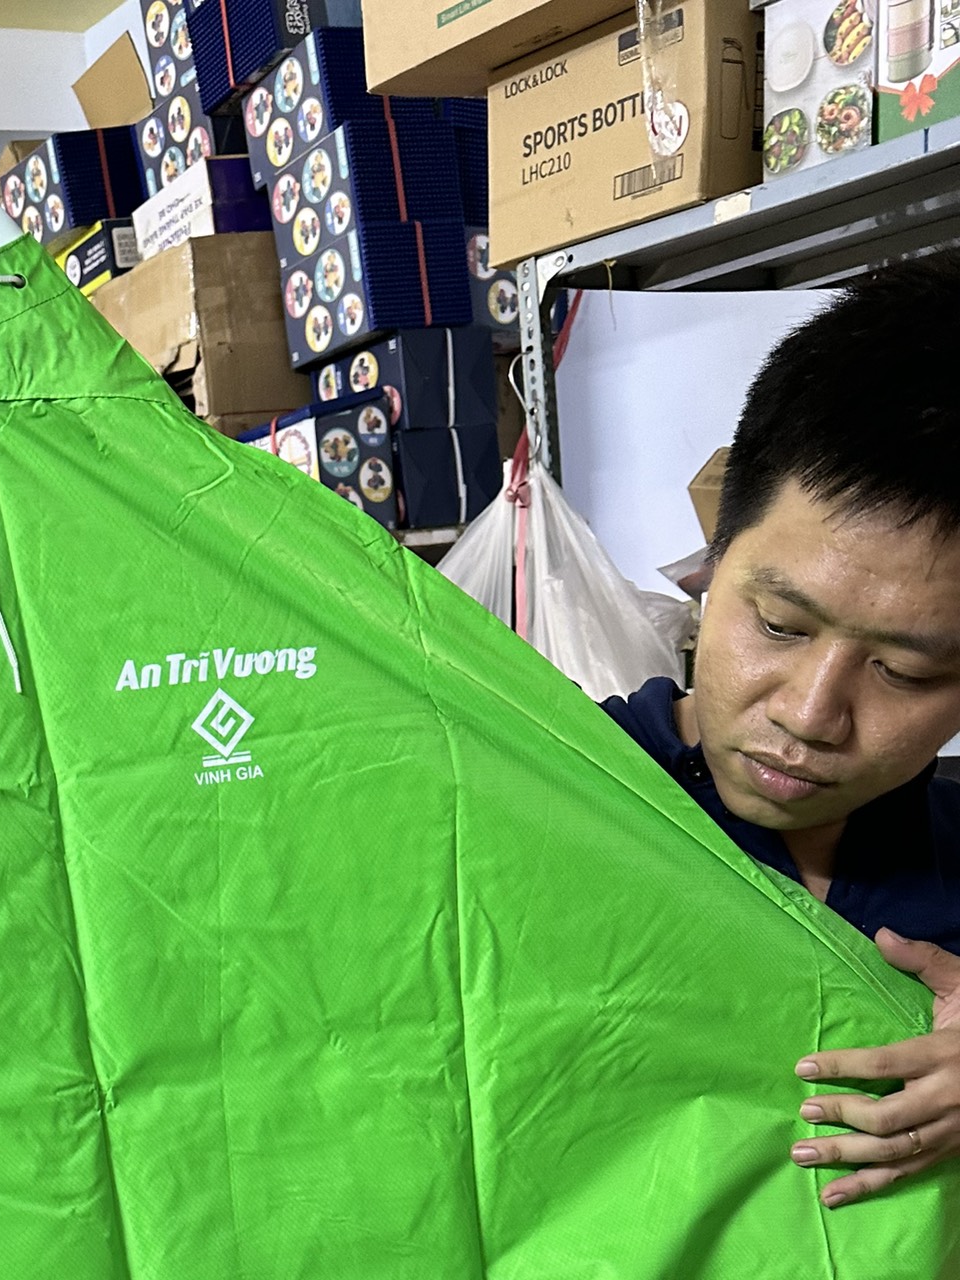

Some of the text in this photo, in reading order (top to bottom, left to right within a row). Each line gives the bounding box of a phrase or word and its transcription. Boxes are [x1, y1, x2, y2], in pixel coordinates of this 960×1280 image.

[522, 113, 588, 158] SPORTS
[522, 151, 571, 185] LHC210
[115, 659, 162, 692] An
[213, 647, 317, 680] Vương
[194, 765, 264, 786] VINH GIA
